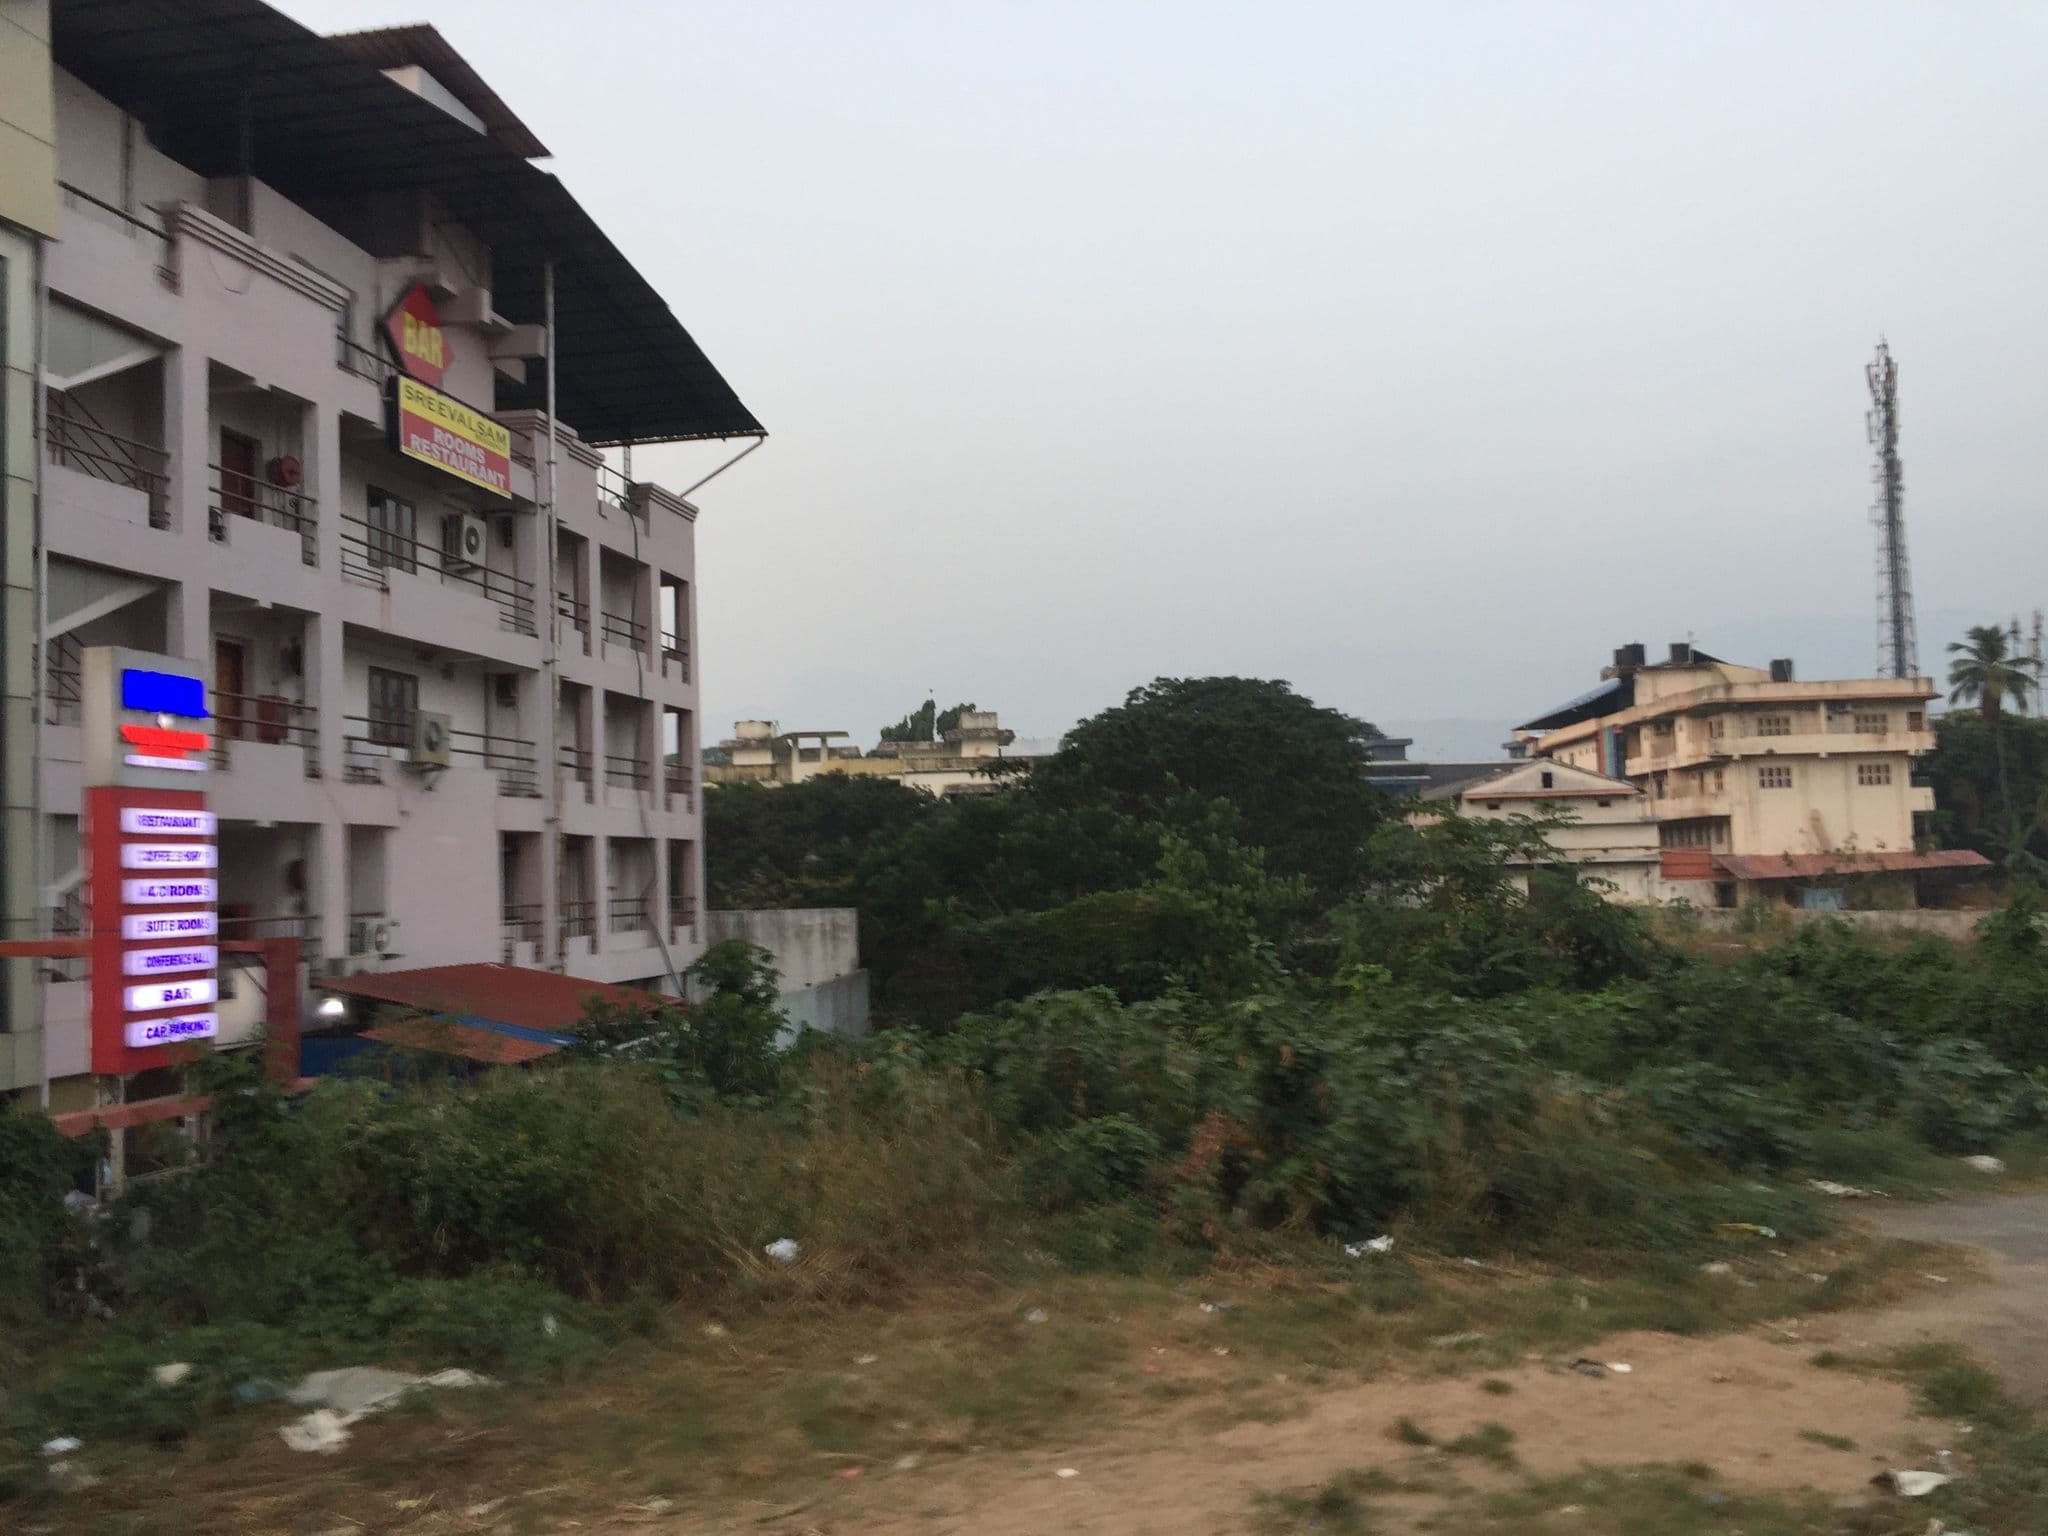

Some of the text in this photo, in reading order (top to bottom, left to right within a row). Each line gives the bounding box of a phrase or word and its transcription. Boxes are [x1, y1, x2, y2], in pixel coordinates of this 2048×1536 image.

[403, 311, 444, 369] BAR
[404, 384, 507, 445] SREEVALSAM
[410, 434, 506, 489] RESTAURANT
[434, 428, 486, 464] ROOMS
[163, 988, 192, 1002] BAR
